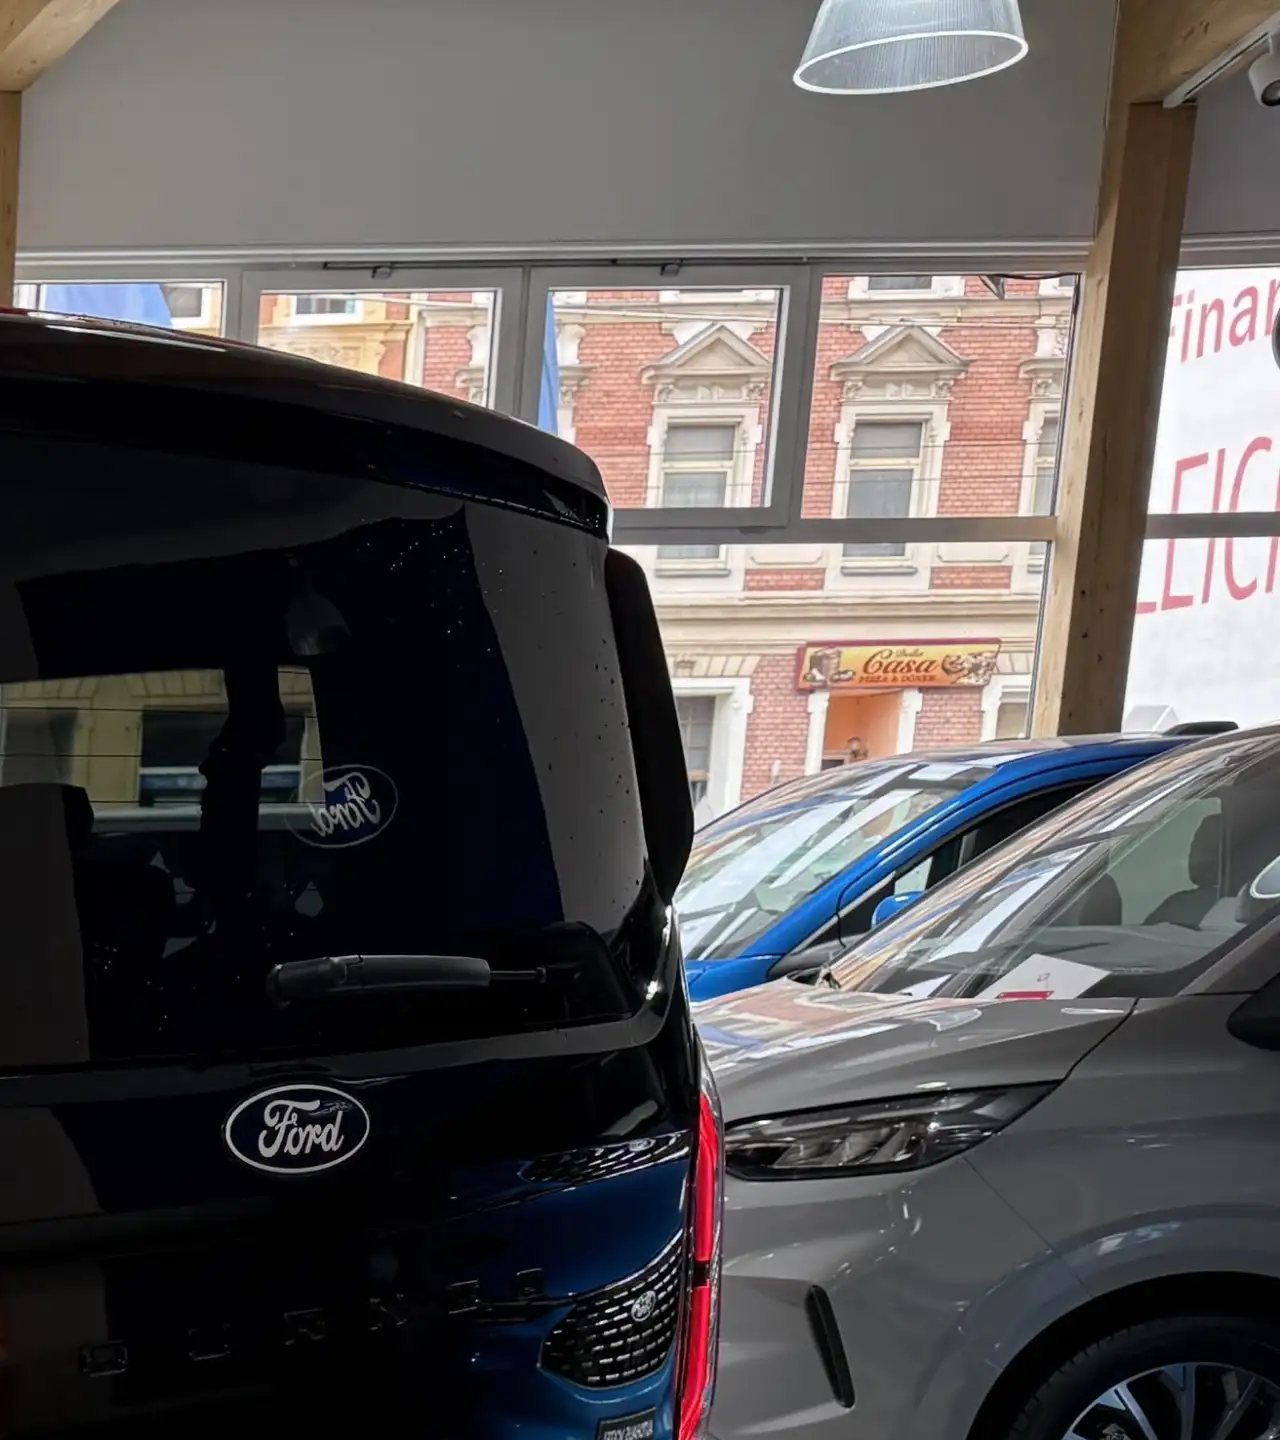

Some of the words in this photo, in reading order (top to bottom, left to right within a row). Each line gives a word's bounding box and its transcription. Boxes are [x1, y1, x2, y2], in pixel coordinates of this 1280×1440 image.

[1171, 278, 1280, 364] ina
[1137, 436, 1280, 614] EIC
[863, 648, 939, 675] Casa
[257, 1098, 345, 1159] Ford
